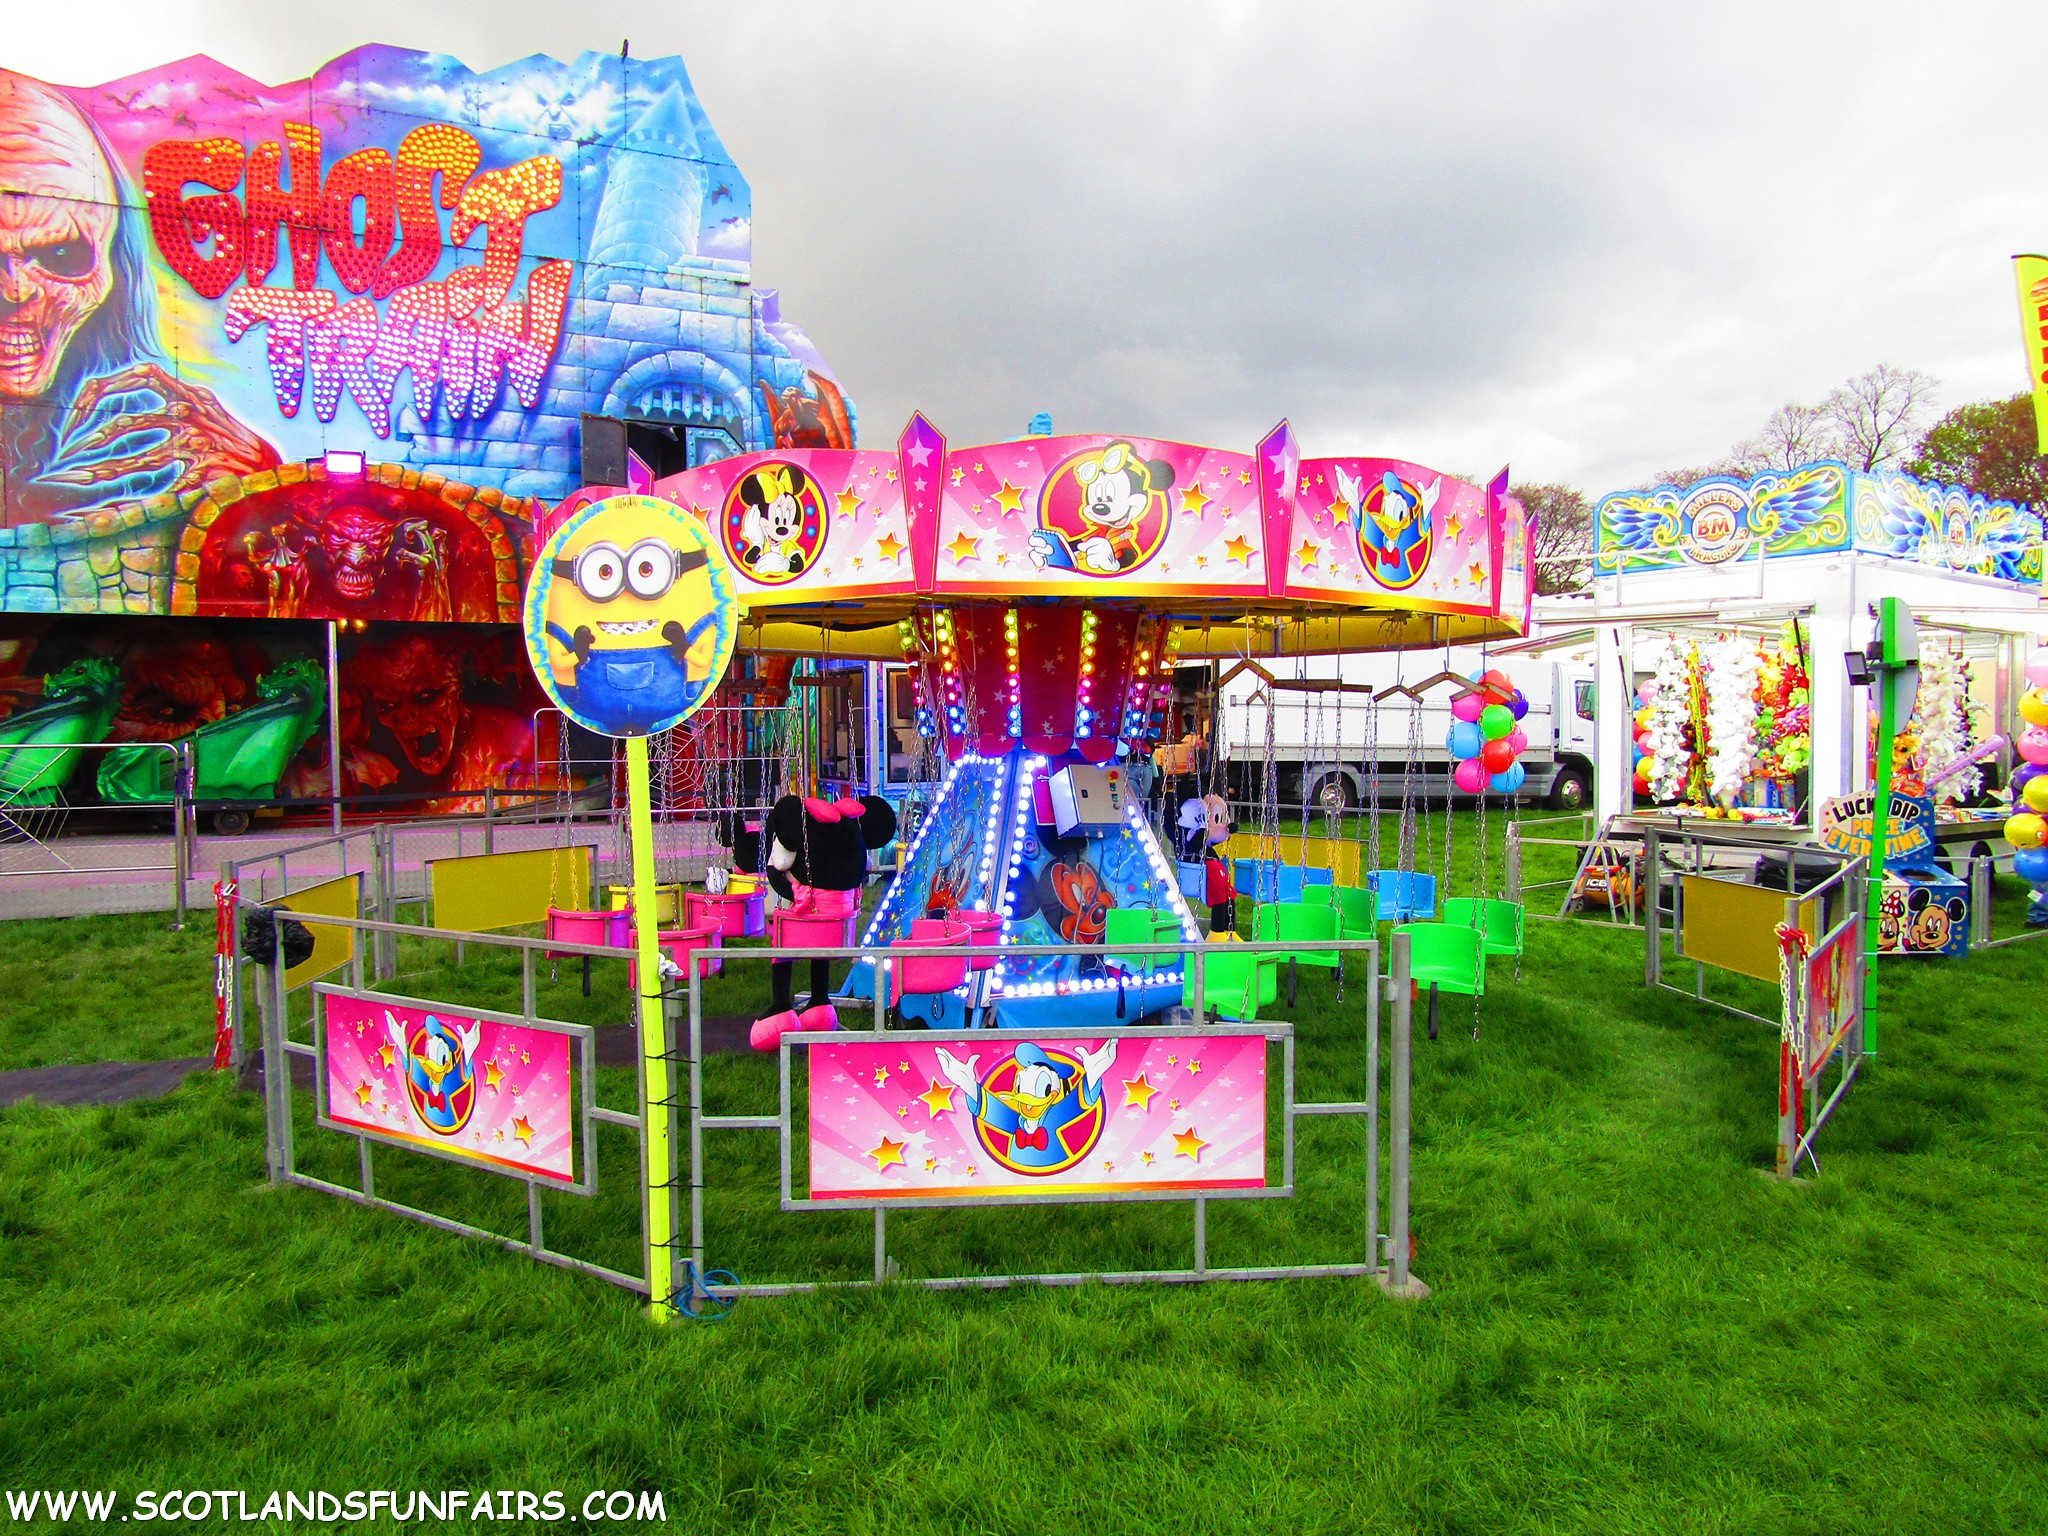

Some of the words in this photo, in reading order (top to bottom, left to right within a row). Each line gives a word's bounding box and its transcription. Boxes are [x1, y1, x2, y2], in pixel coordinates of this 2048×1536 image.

[143, 122, 562, 311] GHOST
[224, 260, 573, 440] TRAIN
[1697, 518, 1731, 537] BM
[1832, 797, 1875, 823] LUCK
[1889, 798, 1920, 822] DIP
[1851, 818, 1901, 836] PRE
[1825, 827, 1873, 856] EVER
